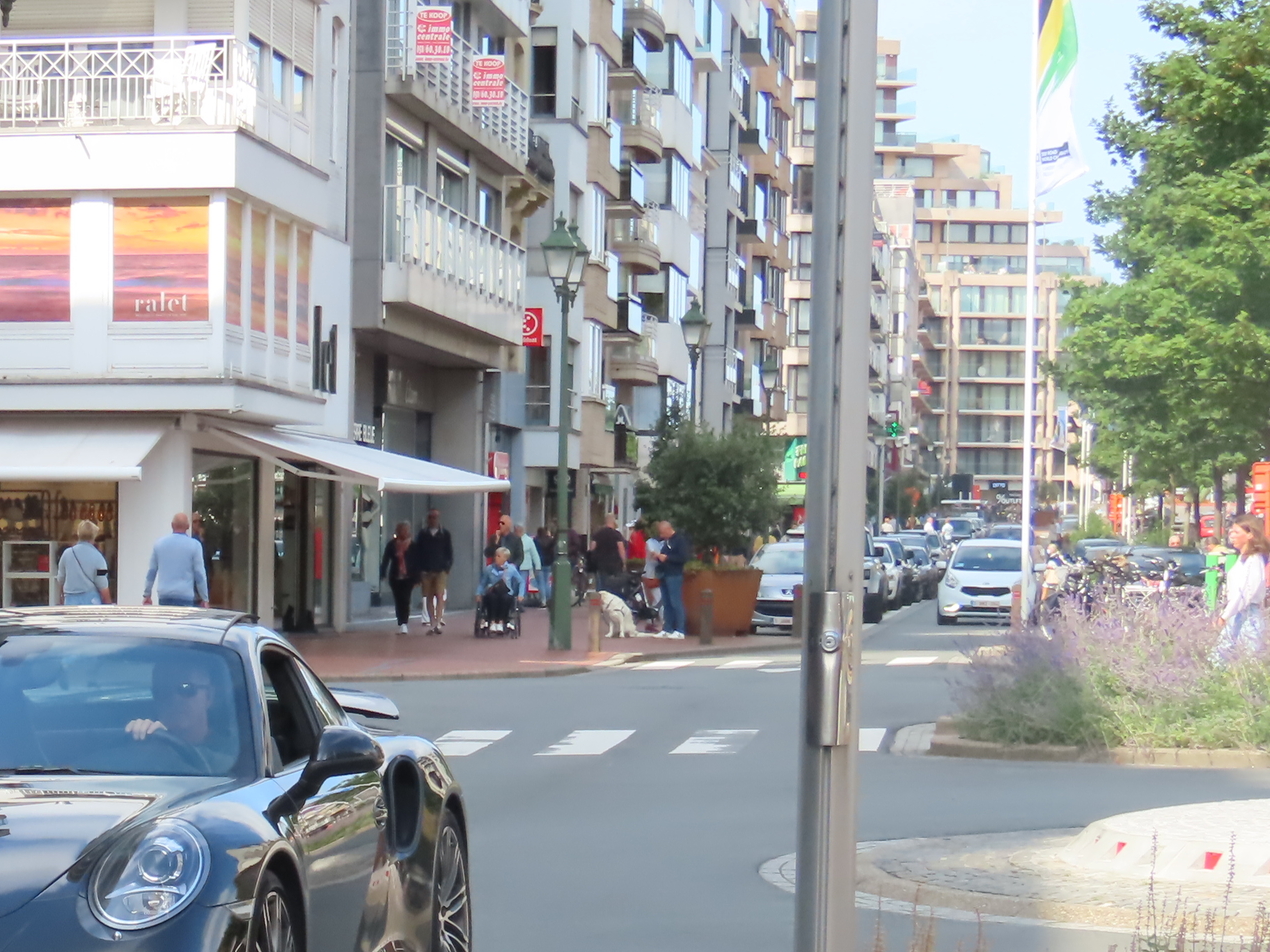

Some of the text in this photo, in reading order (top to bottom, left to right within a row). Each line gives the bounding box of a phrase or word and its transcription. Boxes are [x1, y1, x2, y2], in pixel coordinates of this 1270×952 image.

[428, 24, 450, 33] immo
[417, 32, 450, 41] centrale
[483, 72, 503, 80] immo
[473, 79, 503, 87] centrale
[135, 291, 187, 312] ralet
